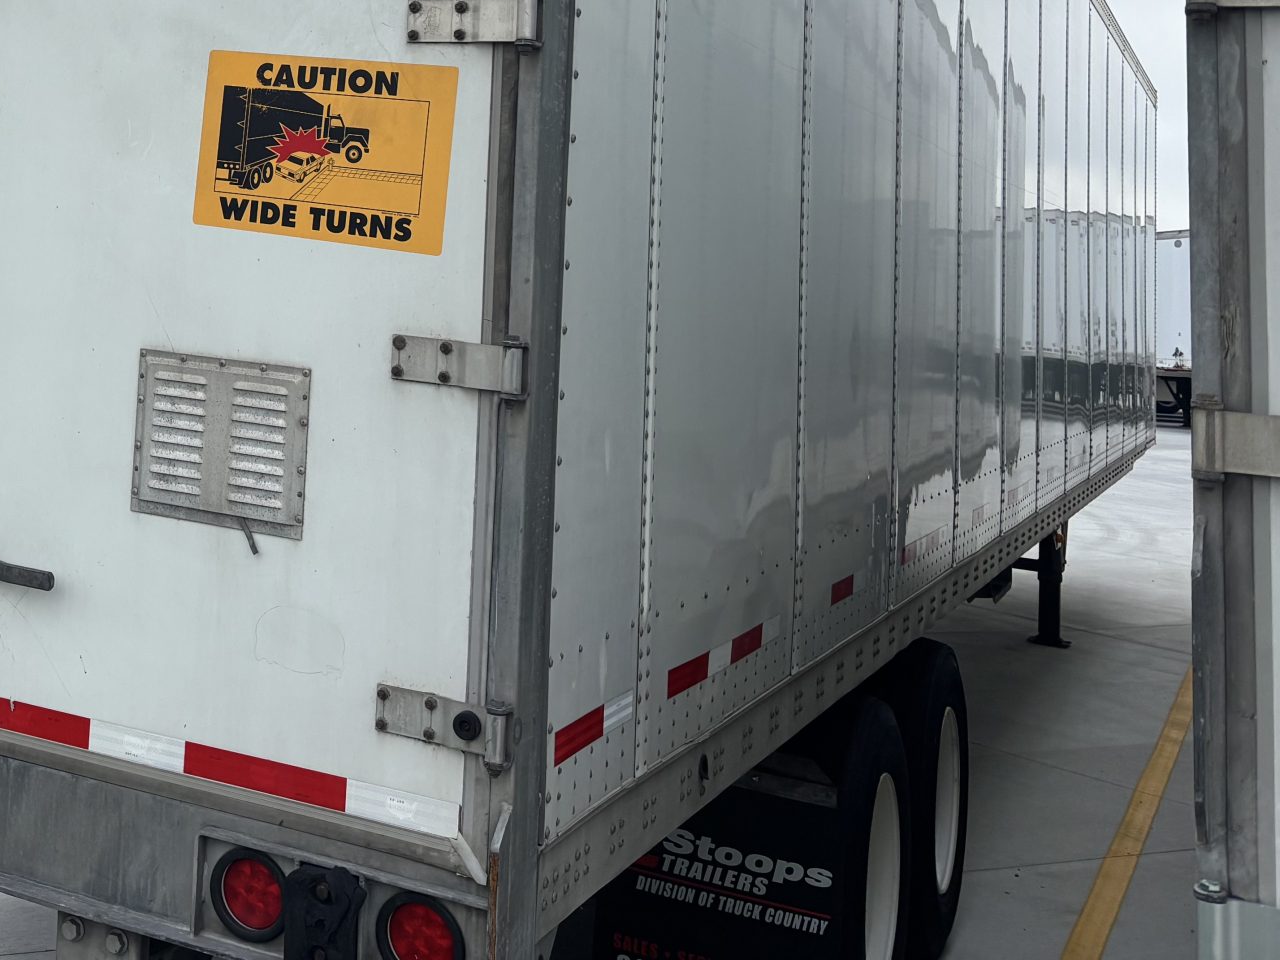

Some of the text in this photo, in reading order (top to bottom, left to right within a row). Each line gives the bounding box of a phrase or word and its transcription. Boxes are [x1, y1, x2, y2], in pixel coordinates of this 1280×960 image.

[256, 62, 400, 96] CAUTION
[219, 196, 412, 242] WIDE TURNS
[660, 853, 769, 896] TRAILERS
[662, 828, 834, 888] Stoops
[636, 875, 829, 936] DIVISION OF TRUCK COUNTRY
